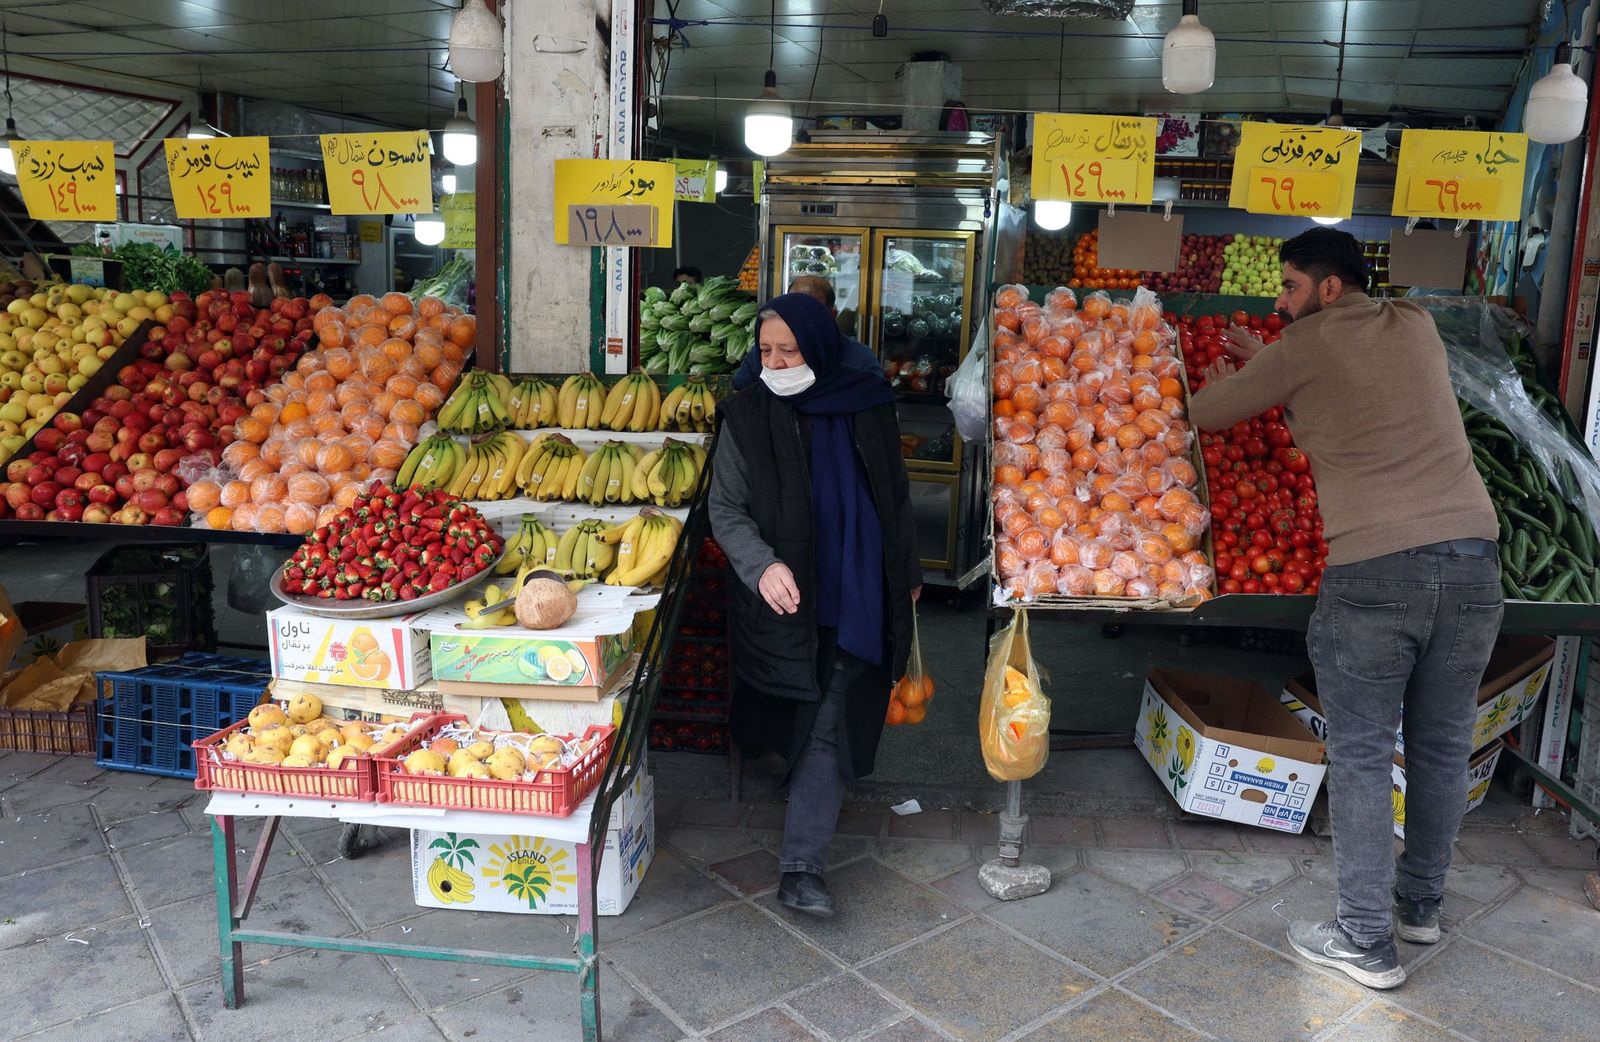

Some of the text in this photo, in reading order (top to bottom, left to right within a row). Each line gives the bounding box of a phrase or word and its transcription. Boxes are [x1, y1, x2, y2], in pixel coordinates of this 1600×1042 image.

[367, 135, 429, 168] تامسون
[1094, 119, 1148, 163] پرتقال
[1302, 134, 1357, 170] گوجه
[25, 149, 56, 182] زرد
[57, 152, 105, 182] سیب
[179, 144, 212, 177] قرمز
[214, 148, 260, 179] سیب
[617, 168, 656, 198] موز
[280, 620, 310, 638] ناول
[281, 638, 311, 653] پرتقال
[1220, 748, 1227, 757] L
[1234, 773, 1284, 790] FRESH BANANAS
[506, 849, 547, 864] ISLAND
